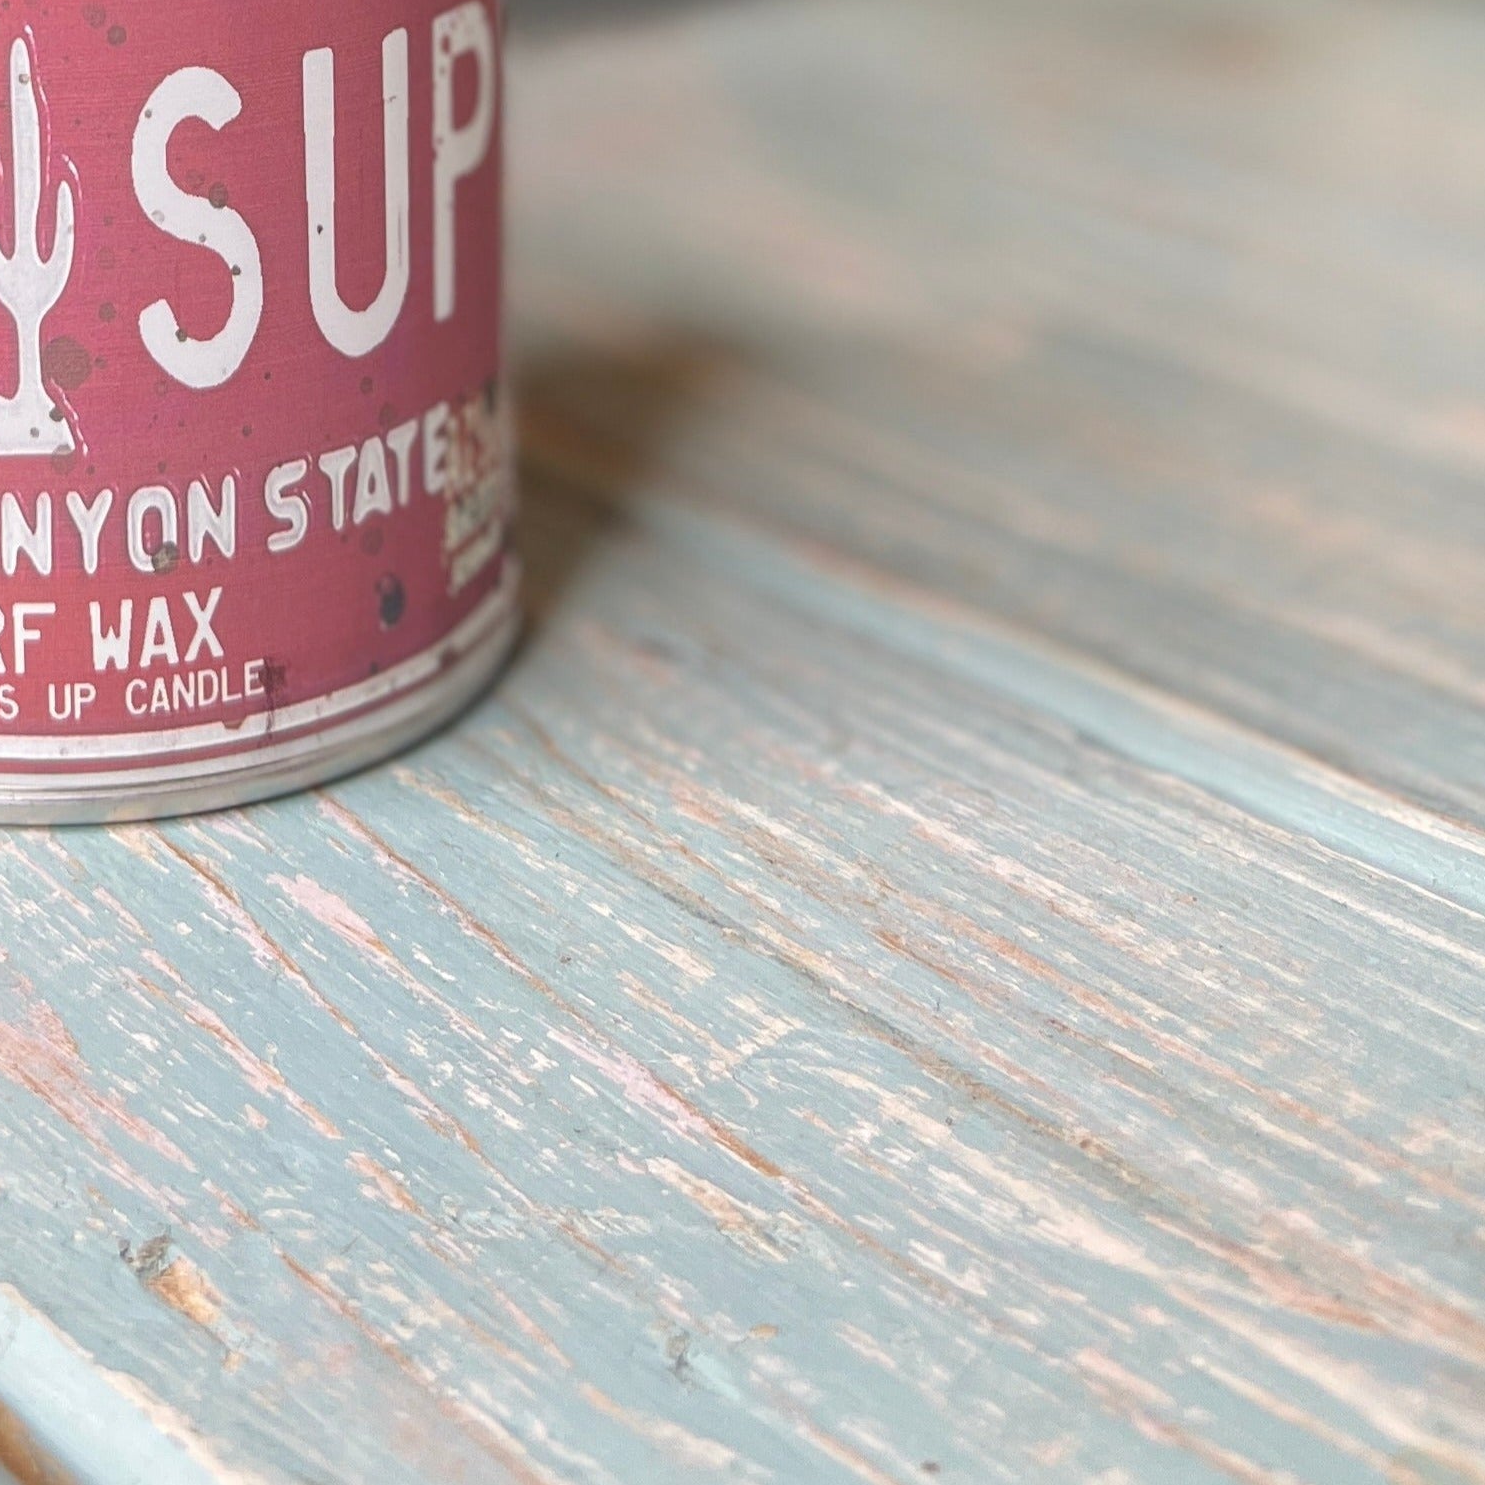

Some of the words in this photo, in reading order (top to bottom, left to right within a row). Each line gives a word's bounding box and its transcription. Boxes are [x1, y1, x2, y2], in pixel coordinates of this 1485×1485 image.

[130, 0, 499, 390] SUP
[264, 400, 450, 552] STATE
[88, 586, 225, 670] WAX
[47, 683, 97, 719] UP
[124, 658, 267, 716] CANDLE
